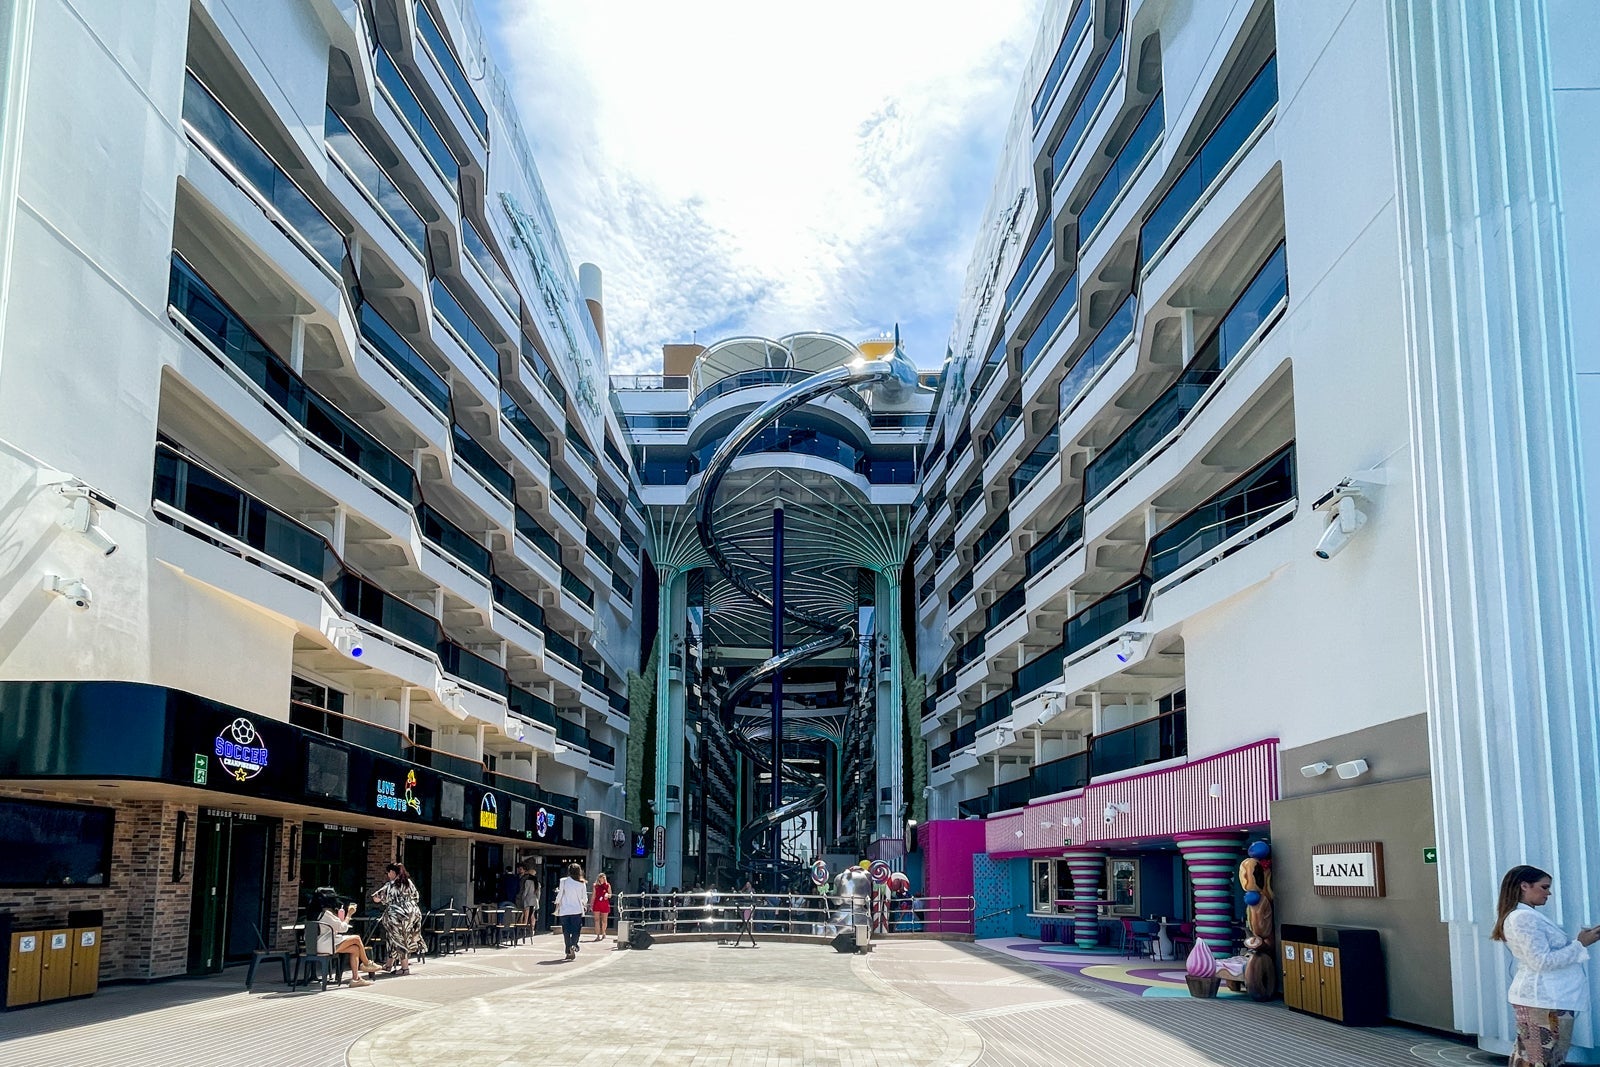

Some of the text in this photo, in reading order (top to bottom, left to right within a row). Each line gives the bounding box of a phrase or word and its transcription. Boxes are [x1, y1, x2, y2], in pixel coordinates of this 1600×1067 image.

[215, 736, 268, 766] SOCCER
[377, 779, 396, 796] LIVE
[376, 794, 407, 812] SPORTS
[1320, 863, 1364, 877] LANAI
